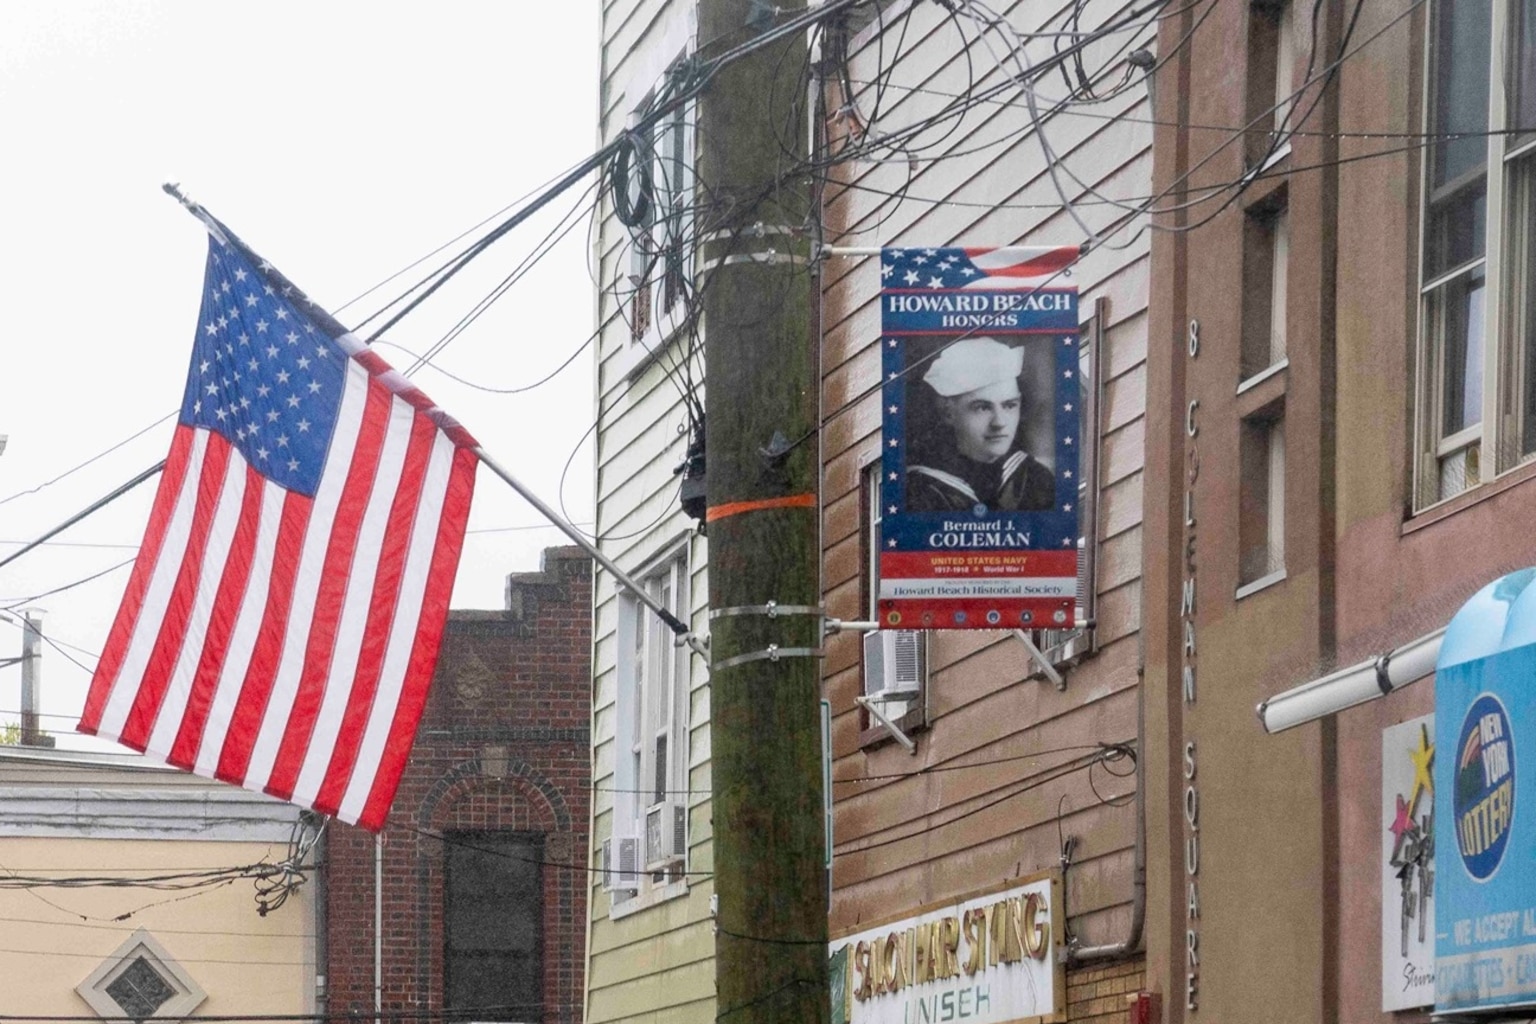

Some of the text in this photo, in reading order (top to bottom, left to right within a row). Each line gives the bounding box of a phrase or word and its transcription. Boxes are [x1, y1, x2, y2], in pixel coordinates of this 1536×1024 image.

[889, 293, 1071, 313] HOWARD BEACH
[942, 314, 1018, 327] HONORS
[943, 520, 1016, 531] Bernard J.
[929, 532, 1031, 547] COLEMAN
[930, 557, 965, 565] UNITED
[967, 557, 1001, 565] STATES
[894, 585, 1062, 596] Howard Beach Historical Society
[1479, 713, 1503, 746] NEW
[1481, 740, 1510, 788] YORK
[1458, 777, 1512, 857] LOTTERY
